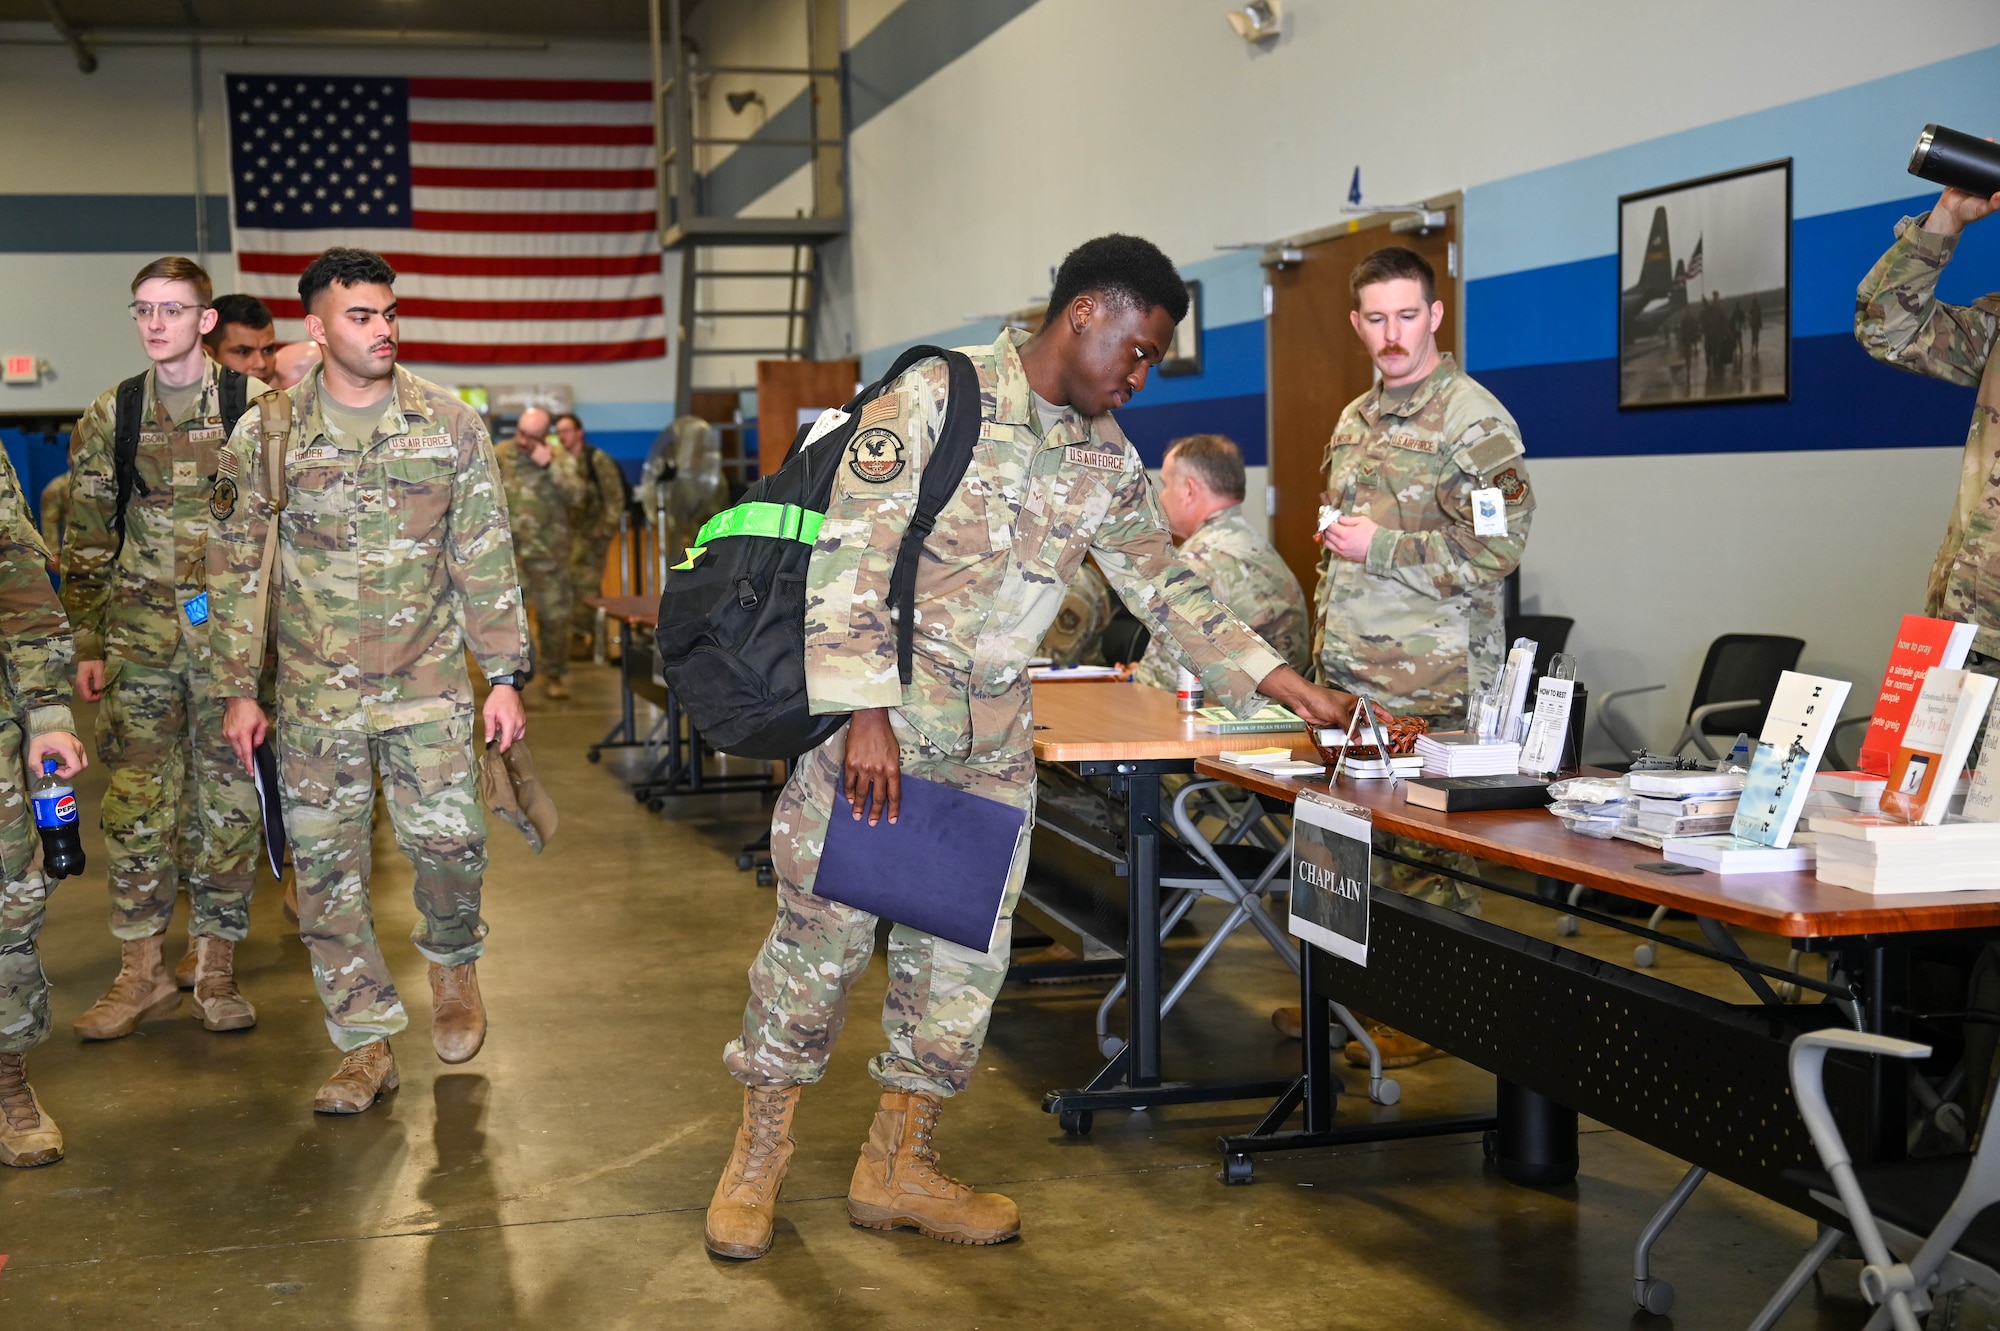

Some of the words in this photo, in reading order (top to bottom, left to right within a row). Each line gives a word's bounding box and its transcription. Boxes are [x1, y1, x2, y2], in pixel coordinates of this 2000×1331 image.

[206, 431, 217, 440] AIR
[408, 438, 421, 448] AIR
[422, 435, 449, 447] FORCE
[1404, 436, 1415, 448] AIR
[1415, 439, 1434, 452] FORCE
[1084, 451, 1097, 465] AIR
[1098, 453, 1125, 470] FORCE
[1897, 639, 1909, 650] how
[1911, 641, 1917, 650] to
[1917, 644, 1932, 656] pray
[1894, 665, 1913, 679] simple
[1913, 668, 1927, 680] guid
[1885, 677, 1894, 688] for
[1893, 681, 1915, 692] normal
[1539, 688, 1550, 697] HOW
[1550, 689, 1556, 697] TO
[1556, 690, 1567, 699] REST
[1880, 692, 1900, 704] people
[1872, 717, 1885, 728] pete
[1884, 720, 1901, 733] greig
[1910, 714, 1925, 732] Day
[1984, 734, 1998, 750] Told
[1978, 752, 1988, 767] Me
[1909, 770, 1917, 789] 1
[1974, 771, 1987, 786] This
[1968, 788, 1993, 808] Before?
[57, 803, 77, 815] PEPS
[1299, 860, 1361, 903] CHAPLAIN
